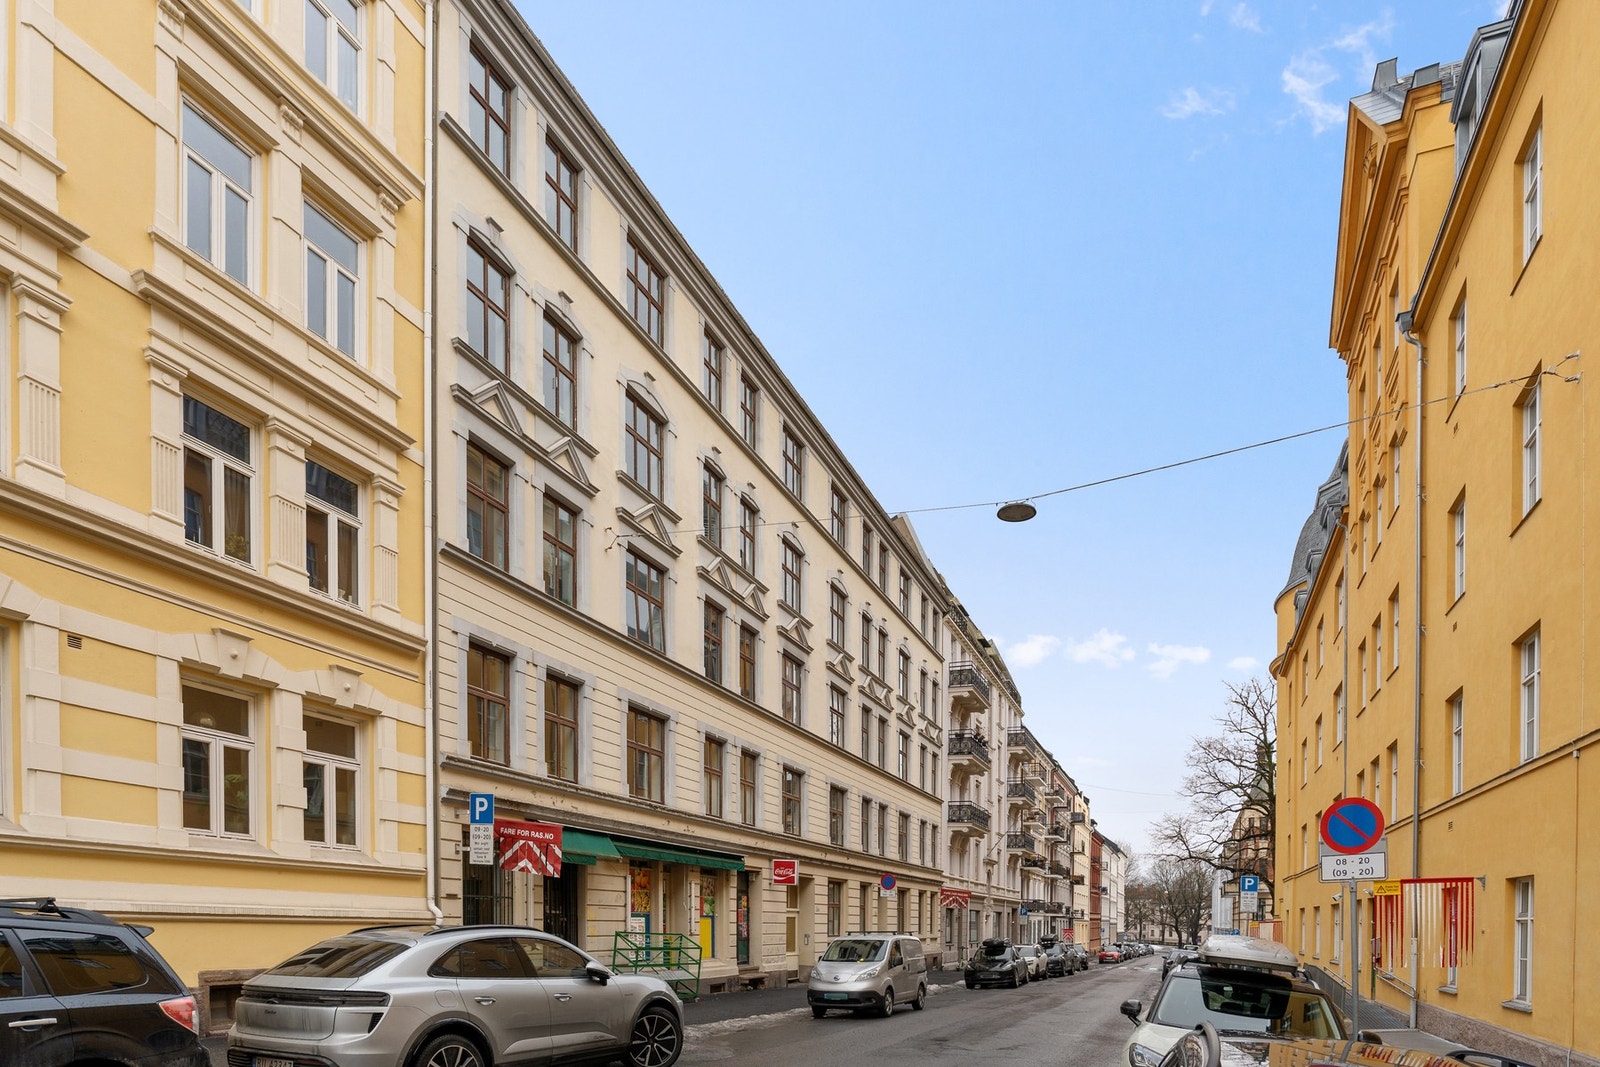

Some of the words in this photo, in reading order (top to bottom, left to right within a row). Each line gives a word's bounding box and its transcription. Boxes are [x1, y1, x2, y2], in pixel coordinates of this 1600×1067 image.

[475, 797, 488, 820] P
[500, 827, 516, 835] FARE
[517, 829, 530, 837] FOR
[530, 830, 554, 840] RAS.NO
[1335, 858, 1347, 866] 08
[1358, 857, 1370, 865] 20
[1332, 868, 1347, 877] (09
[1358, 866, 1374, 876] 20)
[1245, 878, 1254, 890] P
